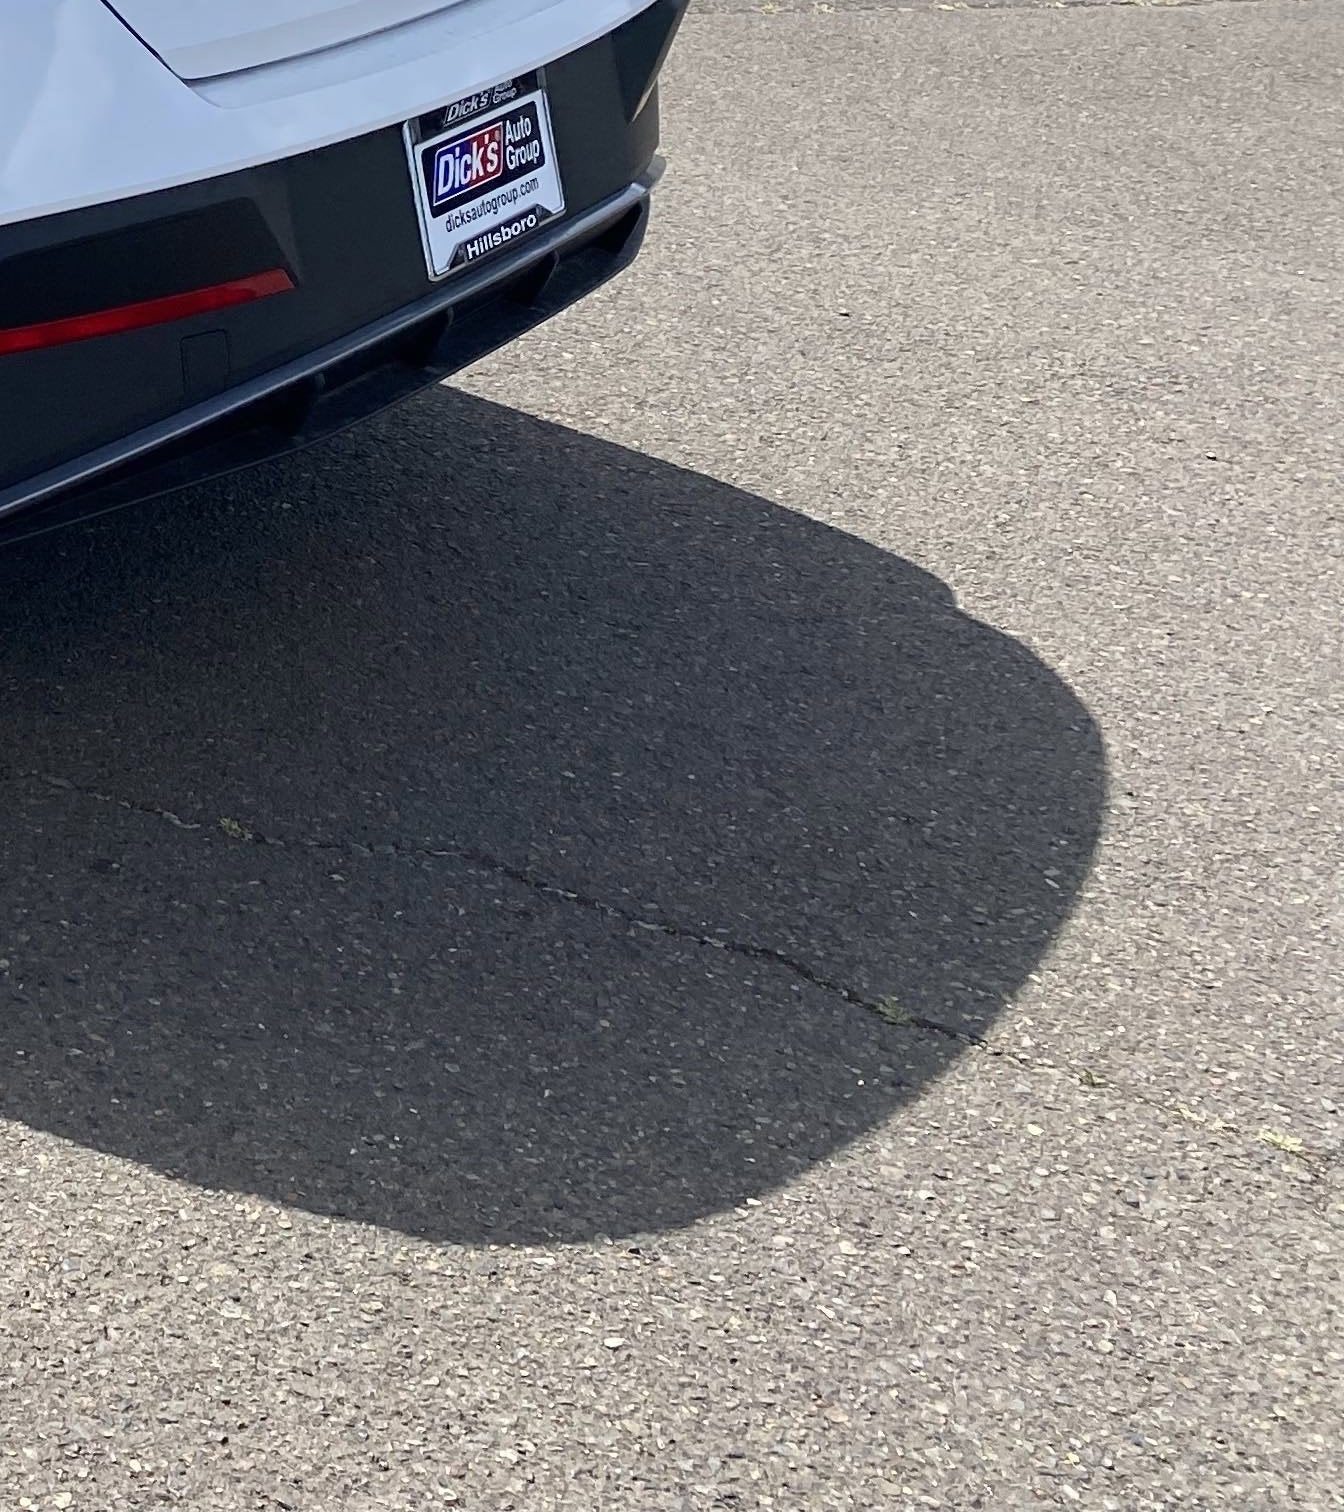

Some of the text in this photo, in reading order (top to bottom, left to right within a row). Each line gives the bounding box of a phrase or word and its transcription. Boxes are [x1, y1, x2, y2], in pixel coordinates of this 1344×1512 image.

[505, 116, 532, 145] Auto
[437, 134, 499, 196] Dick's
[506, 139, 540, 170] Group
[445, 178, 539, 232] dicksautogroup.com
[466, 214, 537, 260] Hillsboro
